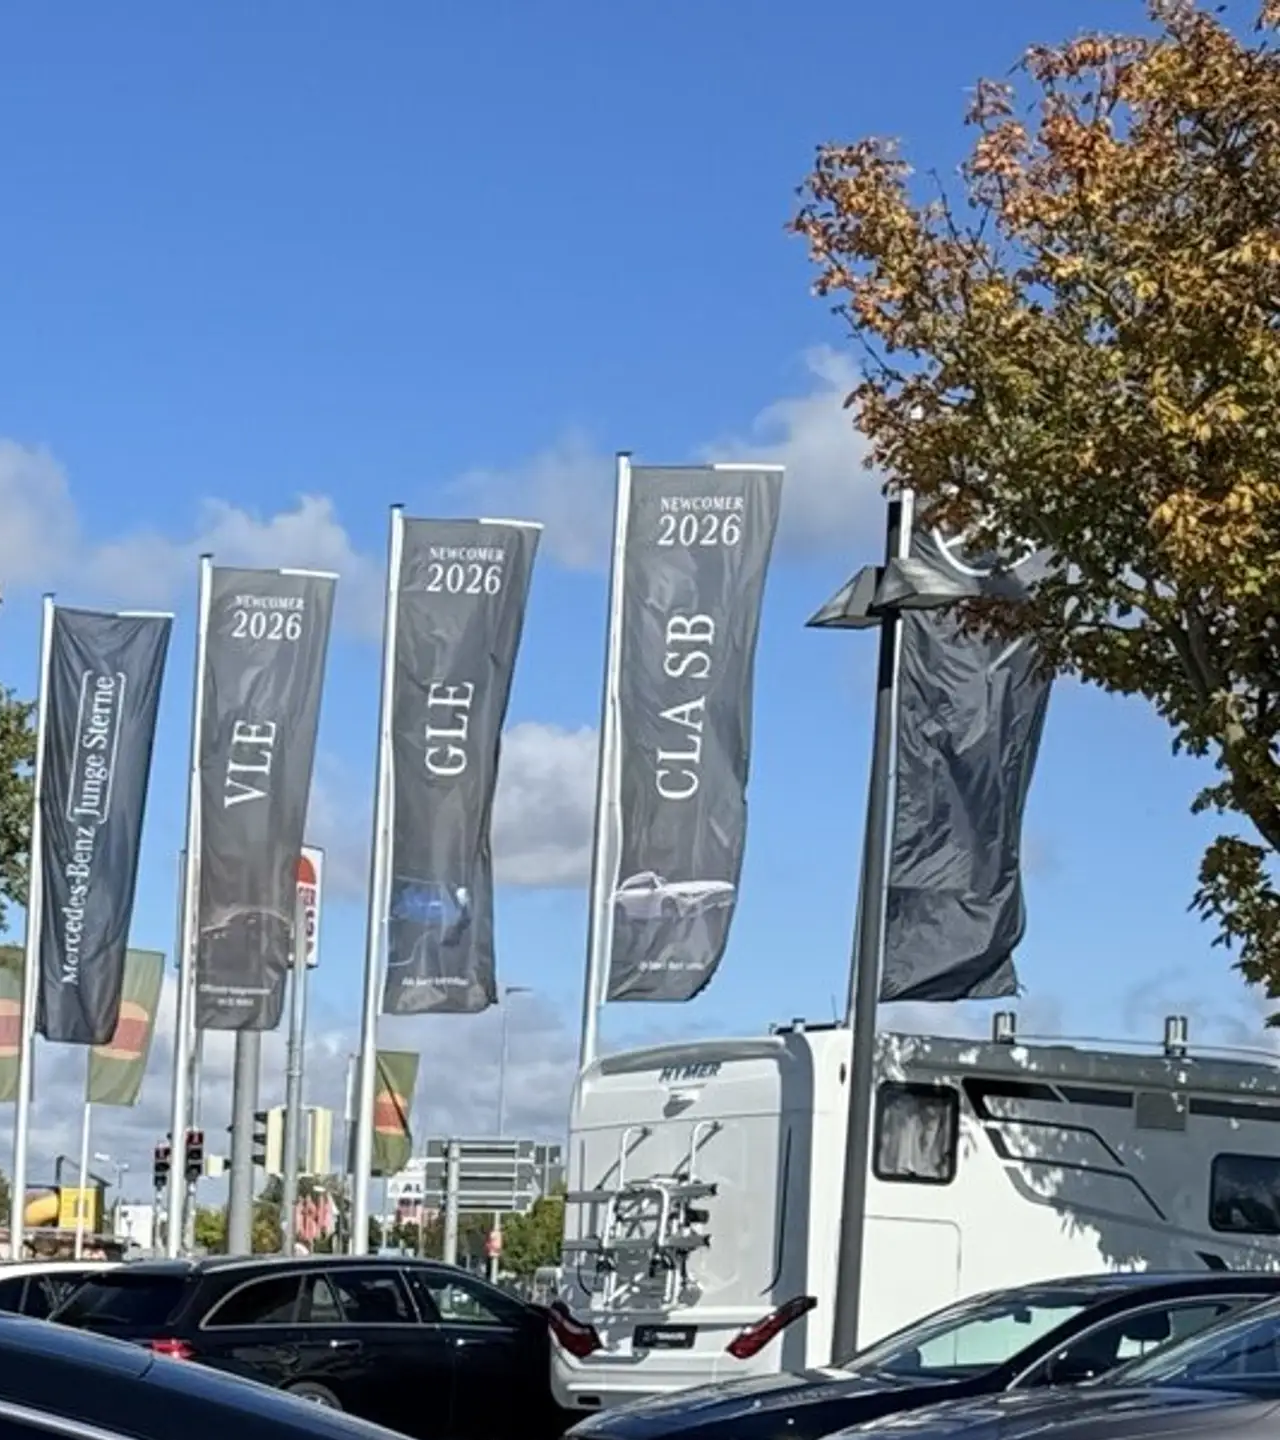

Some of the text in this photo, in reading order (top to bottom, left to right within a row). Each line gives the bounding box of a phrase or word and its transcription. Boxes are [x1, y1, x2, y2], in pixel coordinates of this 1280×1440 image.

[657, 513, 741, 546] 2026
[660, 496, 744, 512] NEWCOMER
[426, 563, 502, 595] 2026
[231, 609, 302, 640] 2026
[424, 681, 475, 776] GLE
[655, 614, 715, 799] CLA SB
[224, 720, 276, 808] VLE
[61, 676, 116, 985] Mercedes-Benz Junge Sterne
